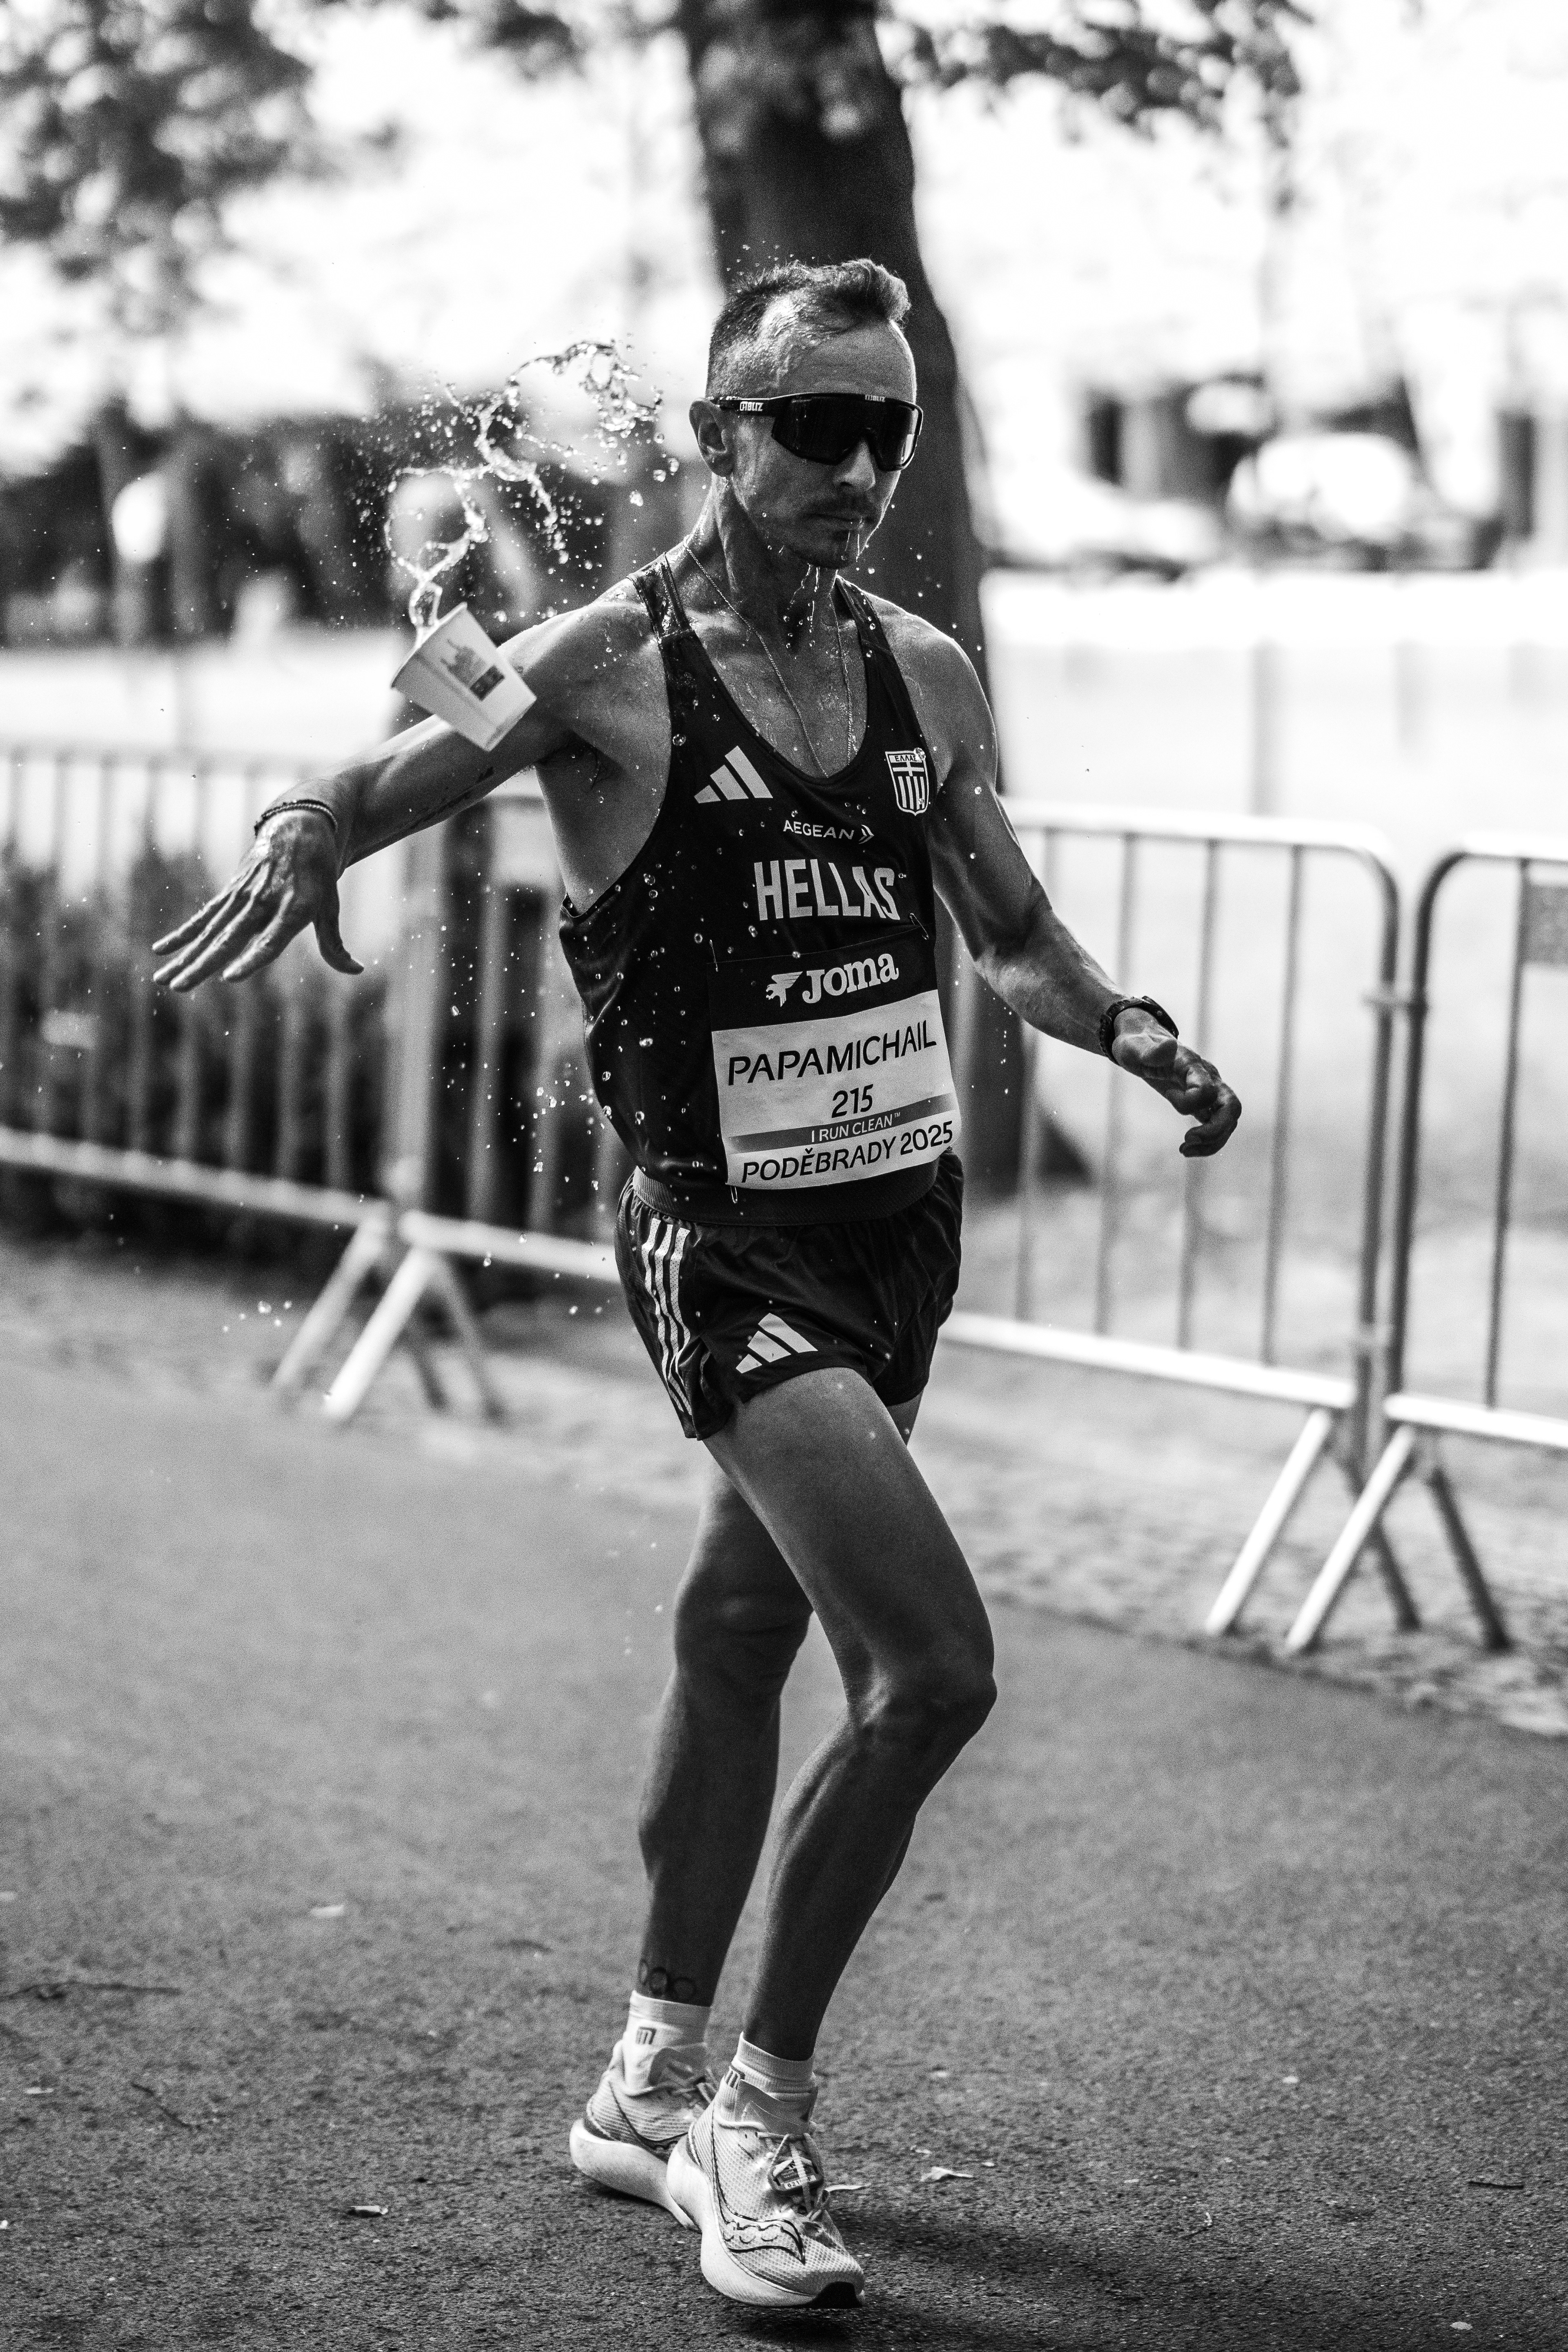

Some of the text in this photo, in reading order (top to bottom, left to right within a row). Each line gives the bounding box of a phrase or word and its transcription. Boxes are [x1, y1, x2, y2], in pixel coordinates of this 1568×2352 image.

[783, 820, 855, 840] AEGEAN
[754, 859, 901, 921] HELLAS
[728, 1020, 937, 1086] PAPAMICHAIL
[831, 1084, 873, 1118] 215
[741, 1121, 953, 1183] PODĚBRADY 2025
[811, 1130, 815, 1143] I
[819, 1124, 849, 1141] RUN
